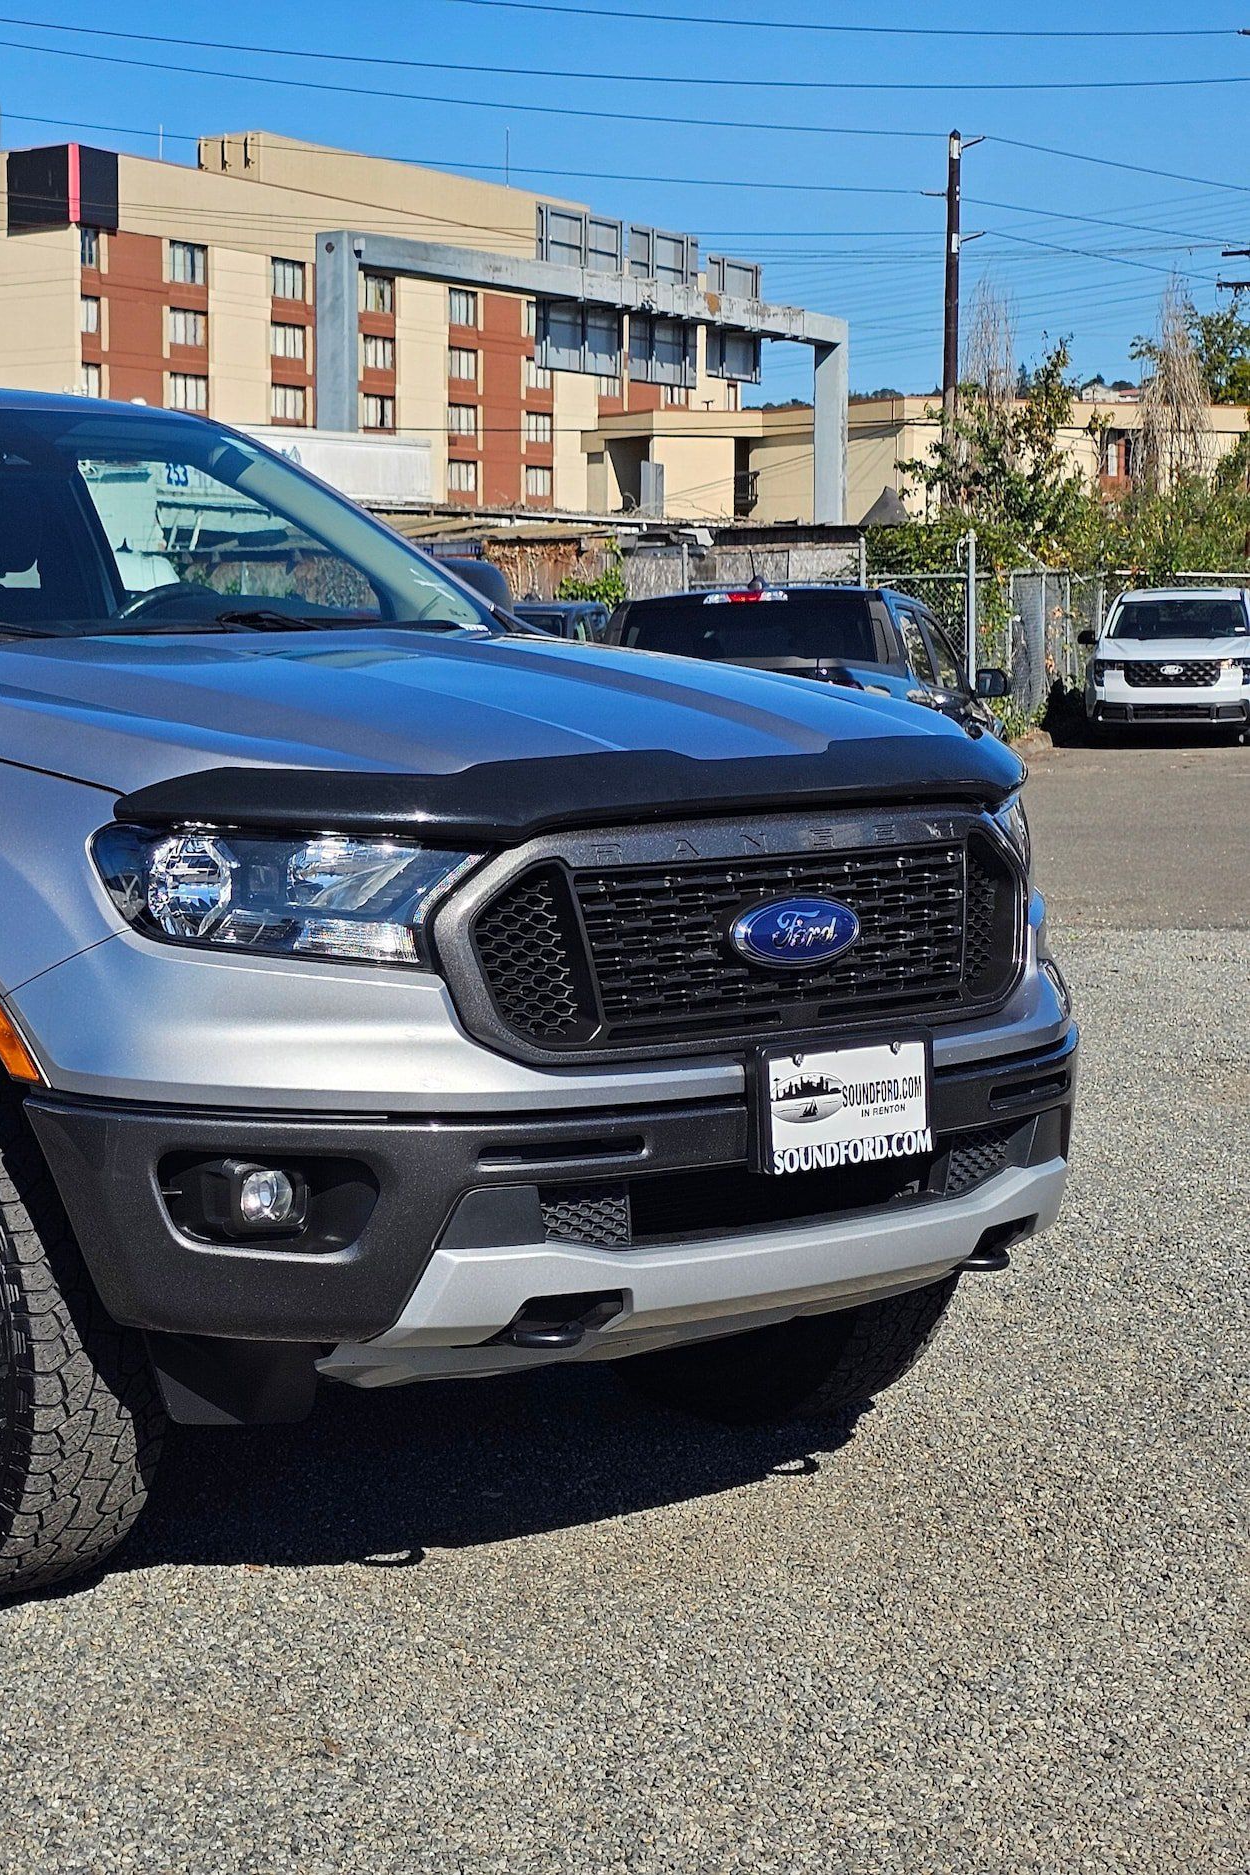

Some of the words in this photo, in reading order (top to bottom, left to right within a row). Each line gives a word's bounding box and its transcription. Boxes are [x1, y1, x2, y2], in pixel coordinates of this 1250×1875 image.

[771, 910, 838, 950] Ford
[842, 1075, 922, 1108] SOUNDFORD.COM
[861, 1108, 870, 1118] IN
[872, 1103, 906, 1116] RENTON
[772, 1126, 934, 1176] SOUNDFORD.COM
